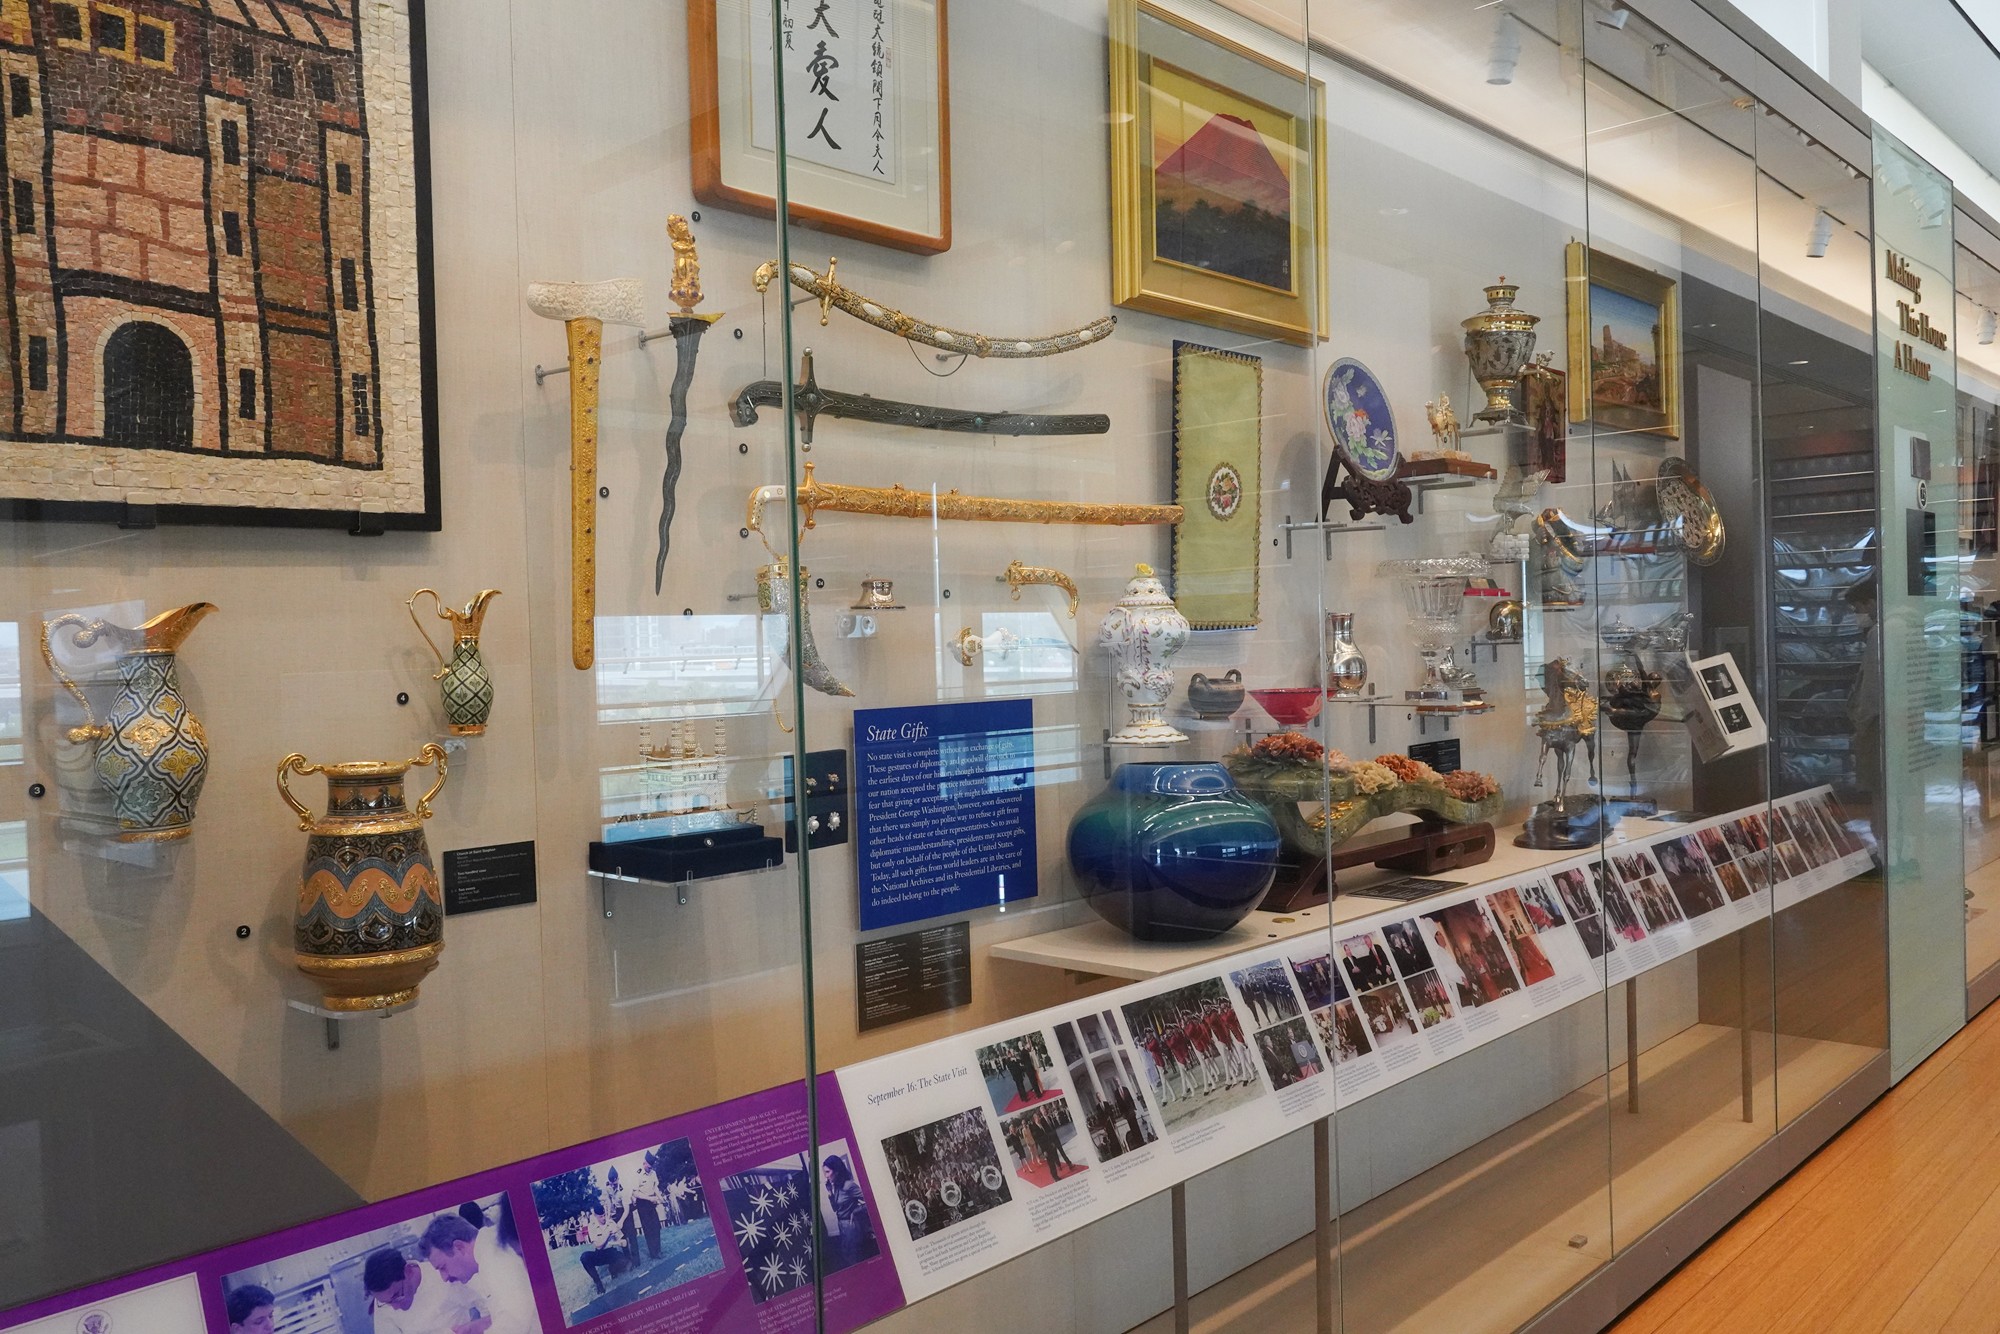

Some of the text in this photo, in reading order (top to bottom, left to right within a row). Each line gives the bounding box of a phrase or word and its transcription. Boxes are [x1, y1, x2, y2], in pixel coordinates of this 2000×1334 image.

[1886, 249, 1922, 304] Making
[1896, 300, 1947, 351] This House
[1894, 340, 1931, 381] A Home
[866, 721, 929, 743] State Gifts
[867, 753, 877, 761] No
[913, 747, 939, 760] complete
[940, 746, 961, 754] without
[970, 743, 994, 754] exchange
[867, 764, 886, 773] These
[887, 763, 911, 774] gestures
[919, 758, 948, 771] diplomacy
[949, 757, 960, 765] and
[961, 755, 984, 766] goodwill
[867, 777, 878, 785] the
[878, 774, 900, 784] earliest
[901, 773, 914, 784] days
[915, 772, 922, 780] of
[955, 767, 975, 778] though
[975, 766, 984, 774] the
[868, 800, 880, 809] fear
[881, 799, 894, 807] that
[894, 797, 913, 808] giving
[921, 793, 948, 805] accepting
[954, 790, 964, 801] gift
[964, 788, 980, 800] might
[880, 787, 899, 796] nation
[900, 784, 925, 796] accepted
[869, 810, 897, 821] President
[898, 807, 920, 820] George
[921, 803, 957, 817] Washington,
[957, 800, 981, 811] however,
[995, 795, 1022, 805] discovered
[869, 824, 881, 833] that
[883, 822, 898, 831] there
[911, 818, 930, 830] simply
[940, 815, 956, 826] polite
[957, 816, 967, 824] way
[976, 810, 991, 819] refuse
[997, 808, 1006, 818] gift
[1006, 806, 1019, 814] from
[869, 835, 886, 845] other
[887, 833, 904, 842] heads
[905, 832, 912, 840] of
[934, 827, 948, 836] their
[949, 822, 990, 836] representatives.
[991, 820, 998, 828] So
[1005, 817, 1019, 825] avoid
[870, 827, 1025, 860] diplomatic misunderstandings, presidents may accept gifts,
[870, 860, 881, 869] but
[882, 858, 895, 870] only
[906, 854, 924, 863] behalf
[925, 852, 931, 860] of
[932, 851, 941, 859] the
[942, 848, 960, 860] people
[961, 847, 968, 855] of
[969, 845, 977, 854] the
[978, 842, 997, 852] United
[998, 840, 1014, 849] States.
[871, 871, 891, 884] Today,
[891, 869, 899, 878] all
[900, 867, 914, 876] such
[914, 865, 928, 877] gifts
[928, 862, 942, 871] from
[943, 860, 959, 869] world
[960, 856, 979, 866] leaders
[996, 852, 1004, 860] the
[1017, 849, 1023, 857] of
[871, 884, 881, 893] the
[883, 880, 909, 891] National
[909, 875, 934, 886] Archives
[935, 873, 945, 882] and
[954, 866, 986, 879] Presidential
[986, 862, 1011, 874] Libraries,
[1012, 860, 1021, 869] and
[871, 898, 880, 906] do
[881, 894, 901, 904] indeed
[902, 890, 923, 903] belong
[930, 887, 940, 895] the
[941, 883, 960, 896] people.
[867, 1066, 968, 1106] September 16: The State Visit
